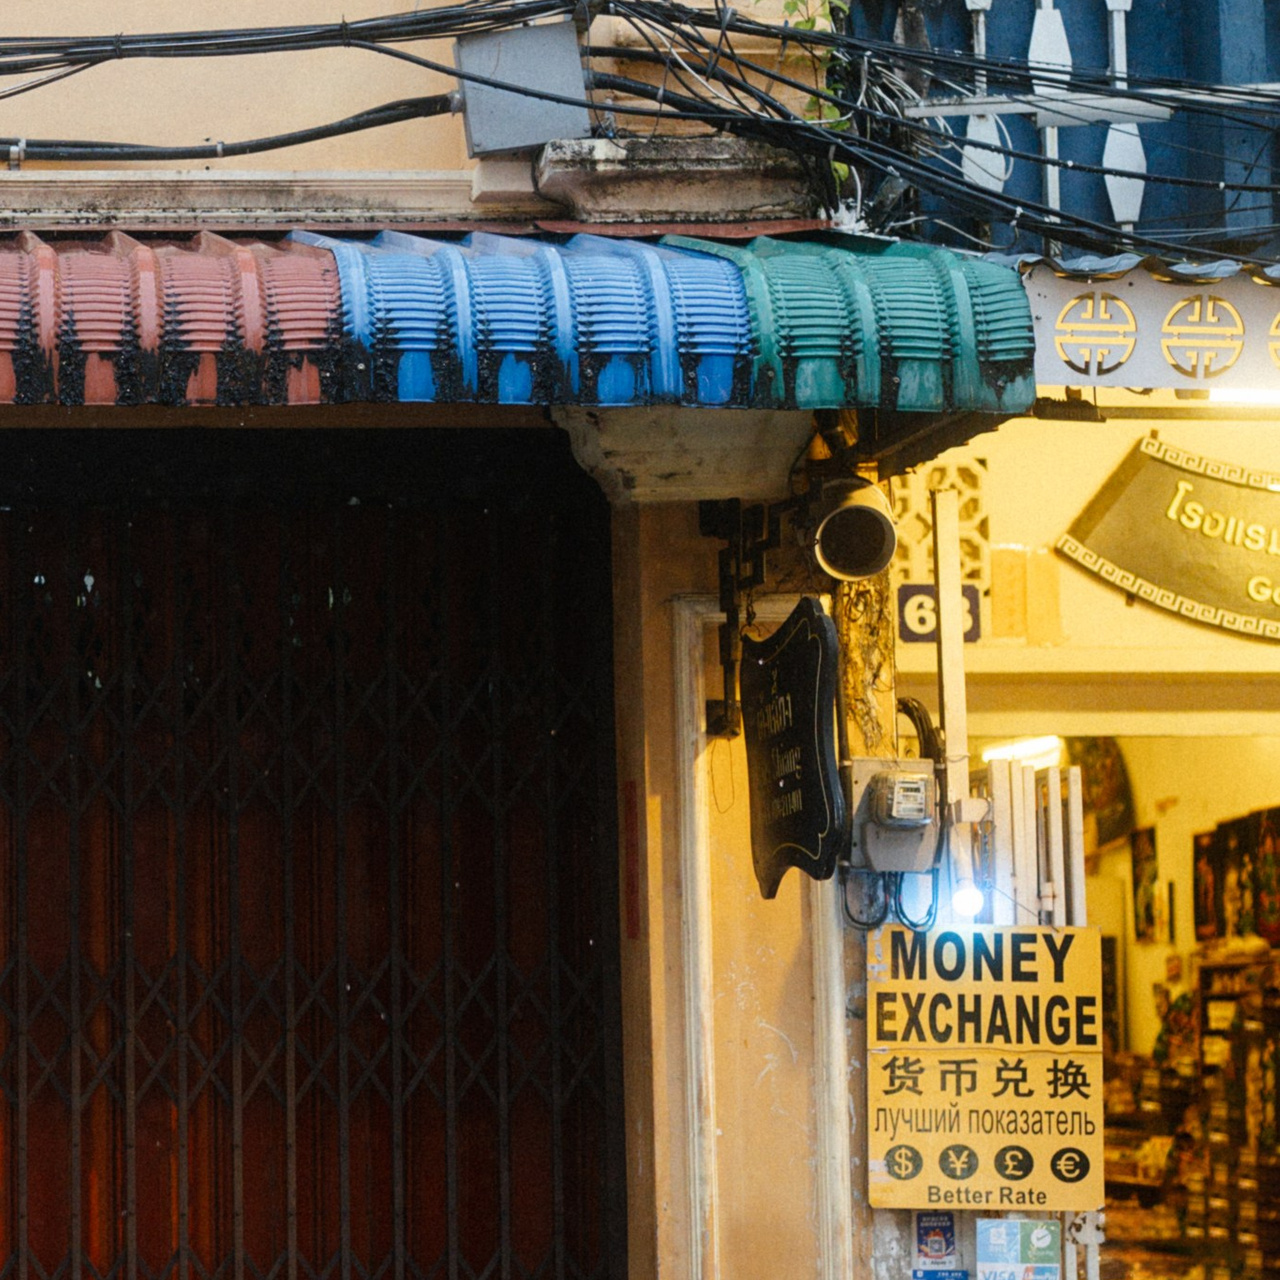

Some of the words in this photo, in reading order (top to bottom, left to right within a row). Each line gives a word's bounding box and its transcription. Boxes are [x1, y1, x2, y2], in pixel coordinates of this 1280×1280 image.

[890, 930, 1075, 983] MONEY
[876, 992, 1098, 1046] EXCHANGE
[882, 1055, 1091, 1100] 货币兑换
[874, 1102, 962, 1141] лучший
[968, 1107, 1096, 1136] показатель
[927, 1185, 993, 1204] Better
[999, 1186, 1047, 1205] Rate
